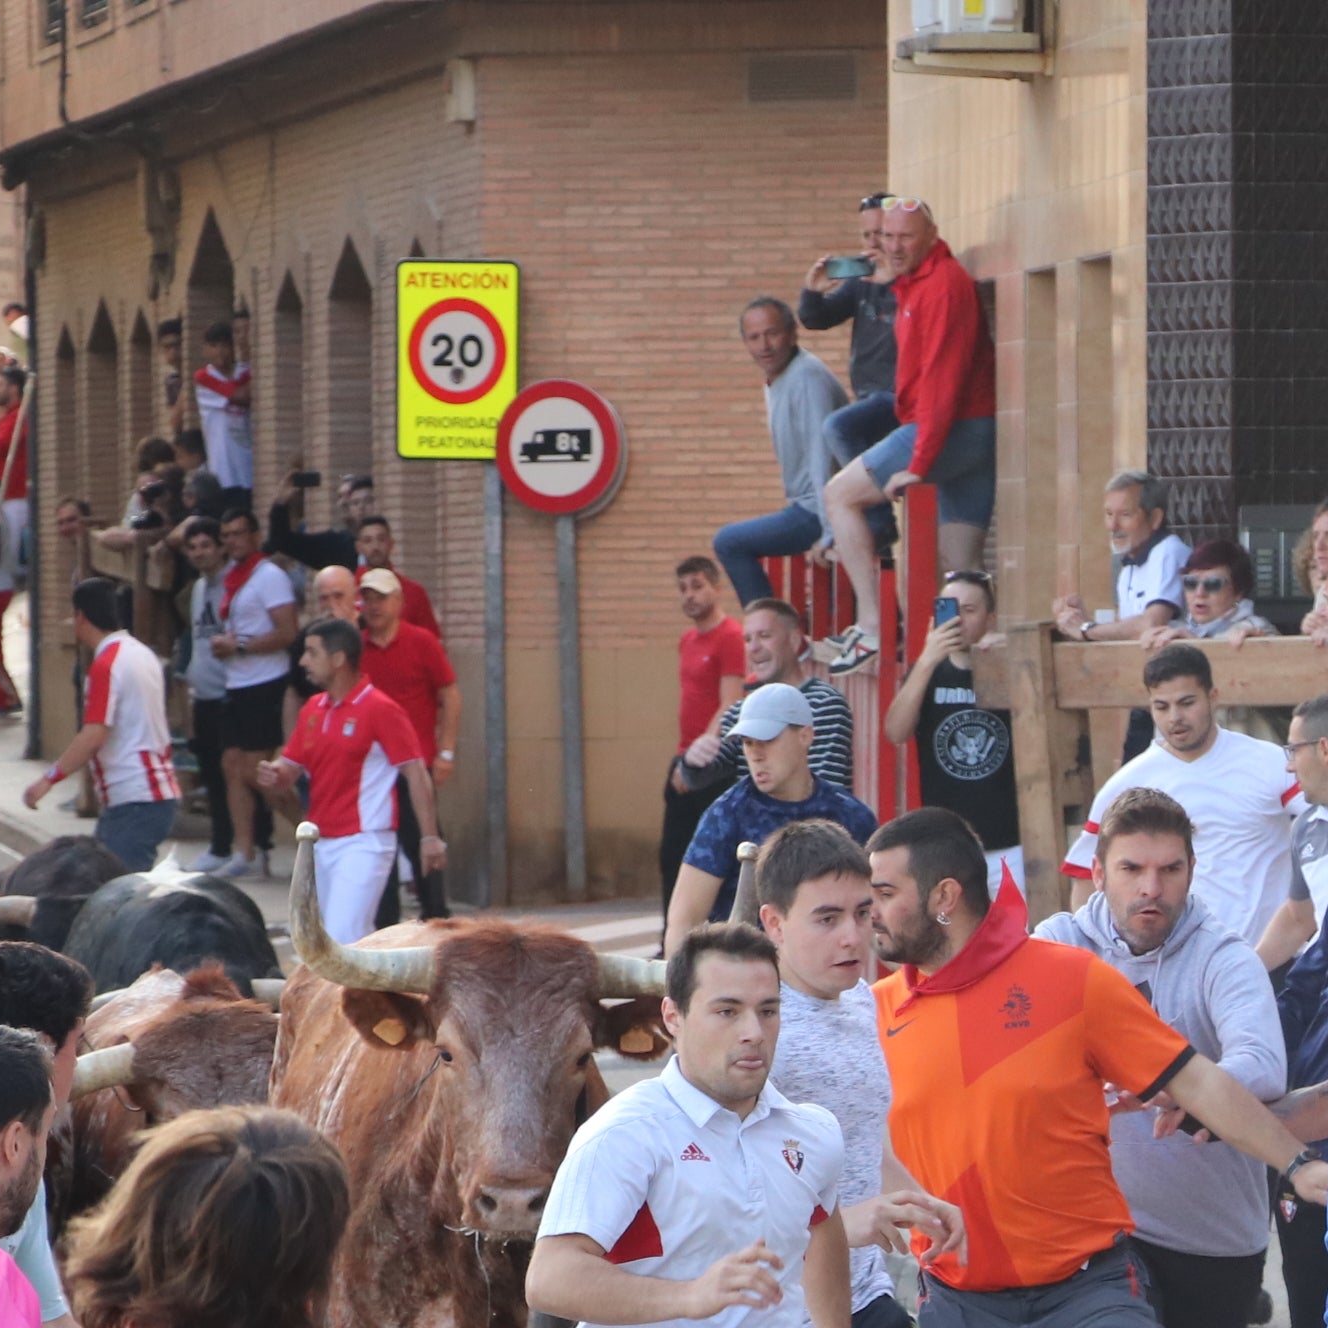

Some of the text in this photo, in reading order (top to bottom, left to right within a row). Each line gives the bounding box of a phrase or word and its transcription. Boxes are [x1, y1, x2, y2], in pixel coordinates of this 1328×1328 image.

[405, 269, 509, 290] ATENCIÓN
[431, 333, 483, 368] 20
[415, 416, 498, 430] PRIORIDAD
[418, 436, 496, 450] PEATONAL
[555, 431, 581, 453] 8t
